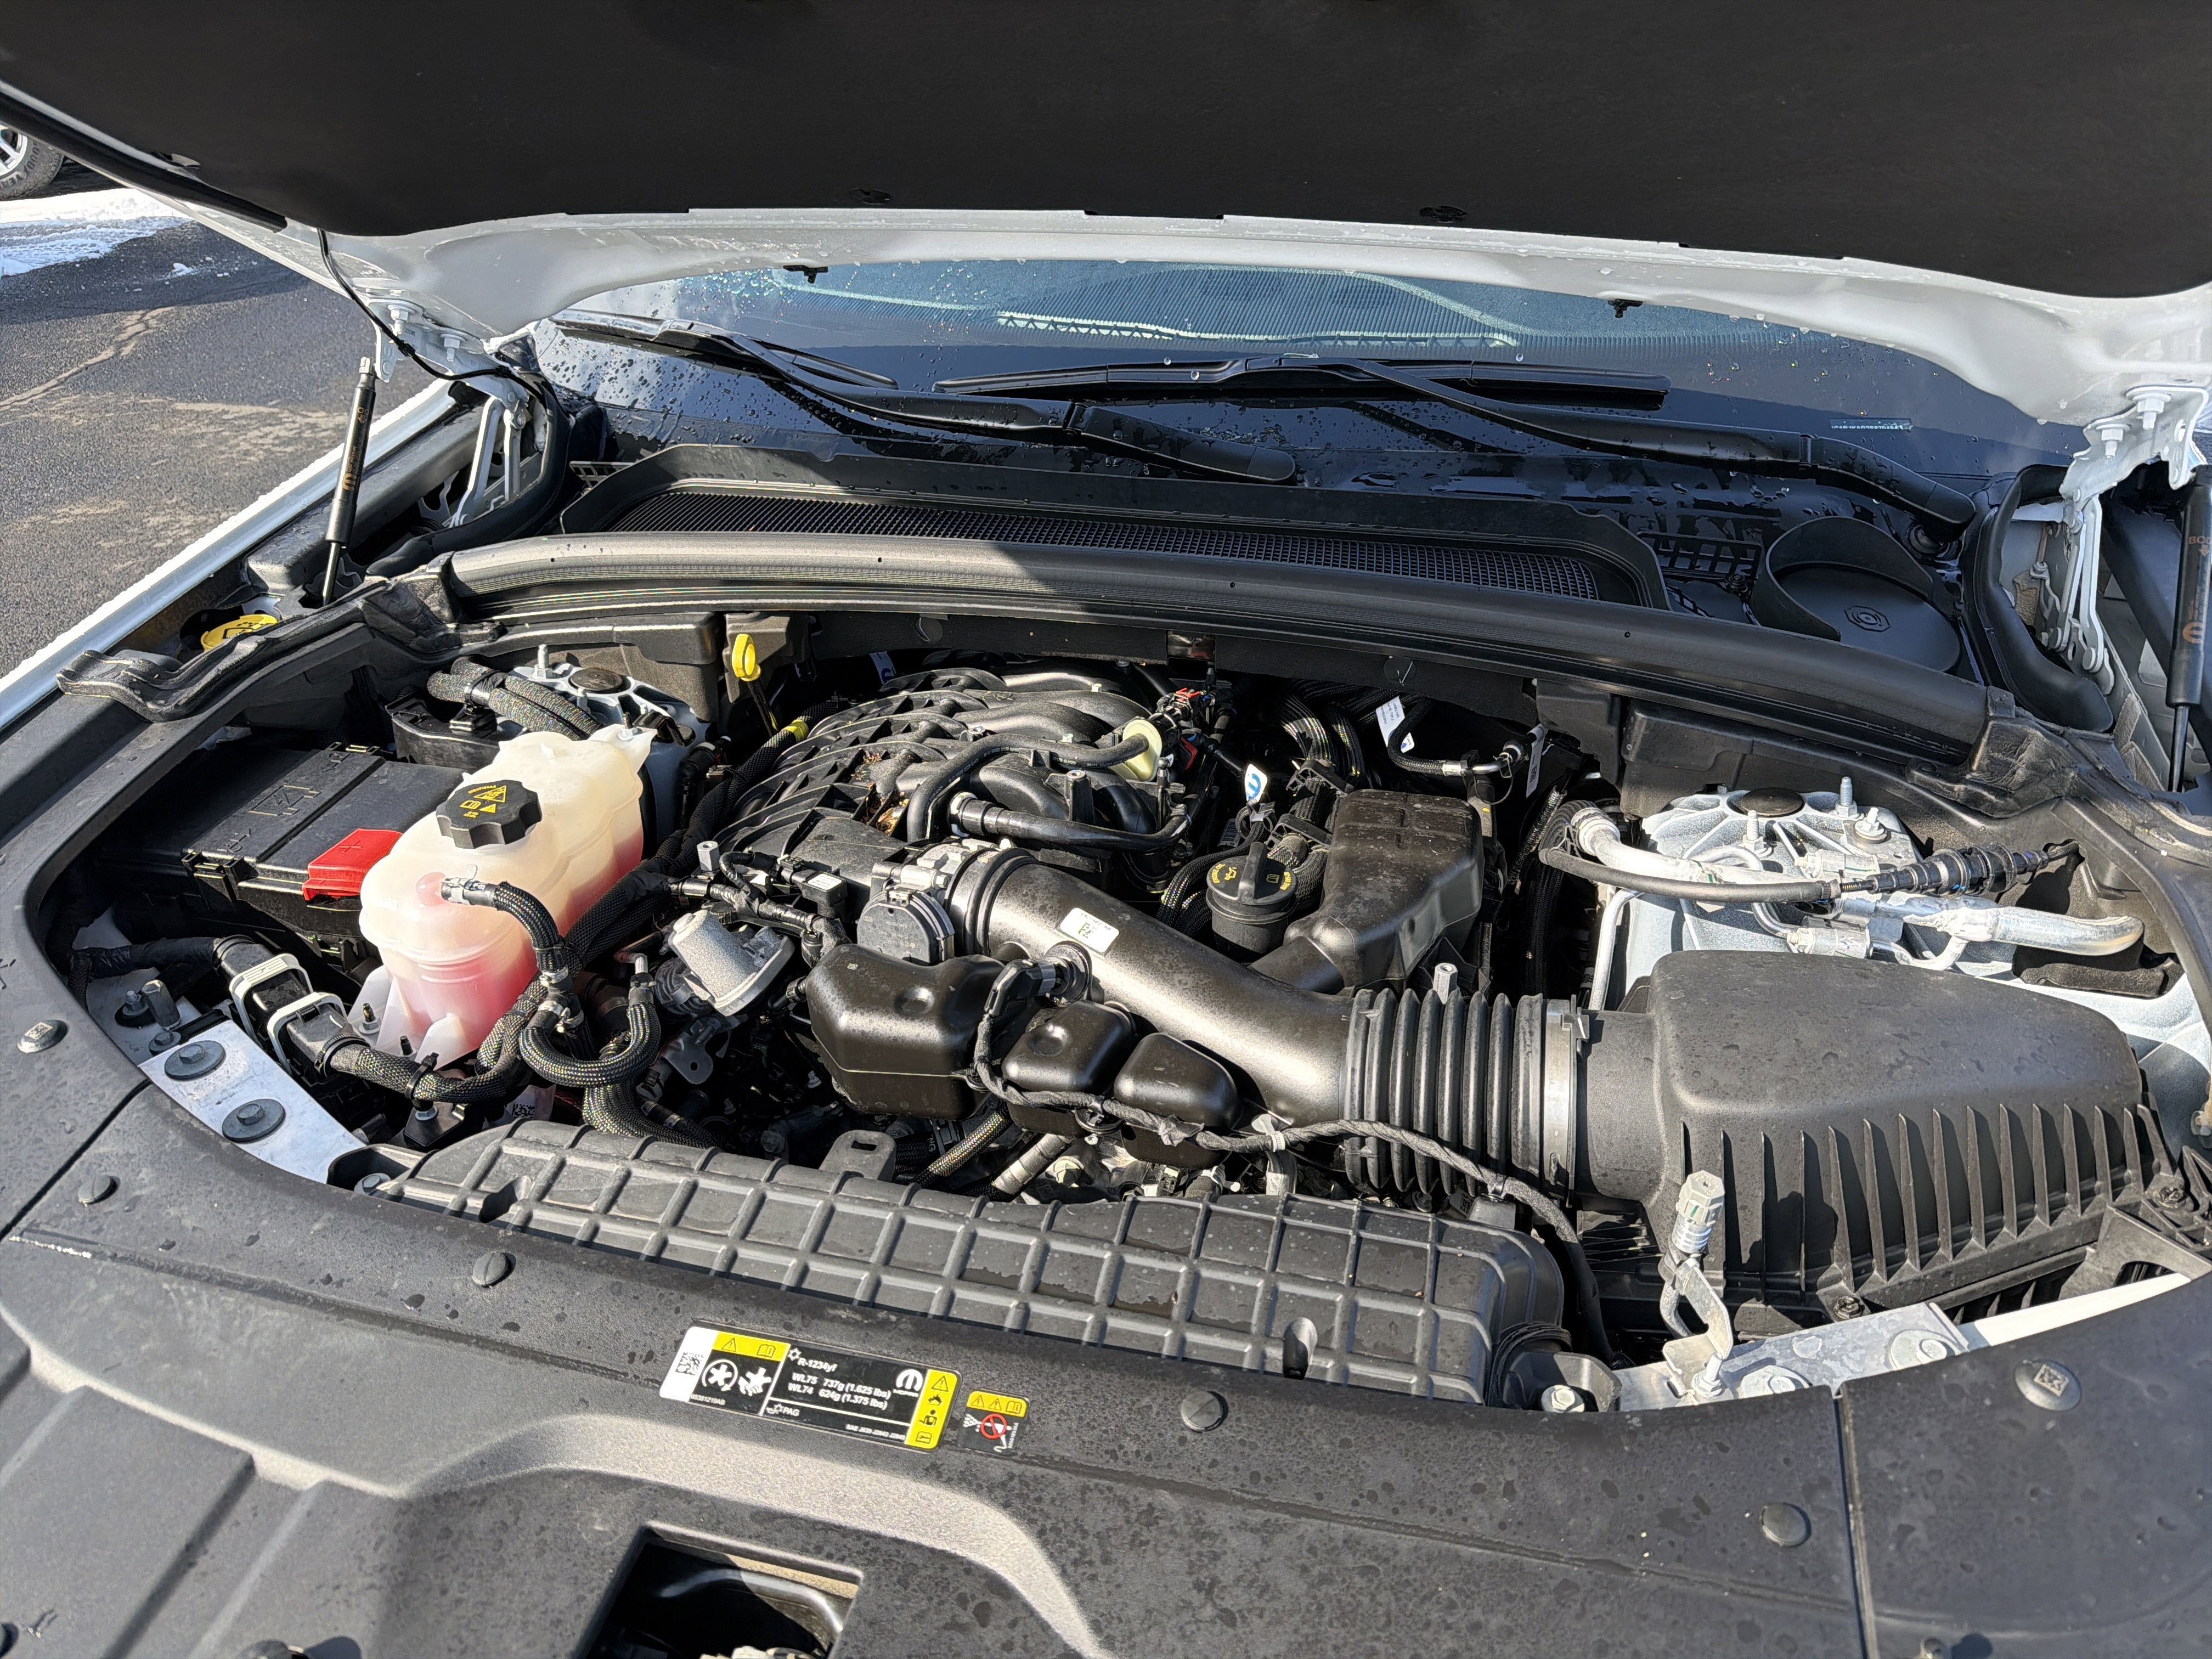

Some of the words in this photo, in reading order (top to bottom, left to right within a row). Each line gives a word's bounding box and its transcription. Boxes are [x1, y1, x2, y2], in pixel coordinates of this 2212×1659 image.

[2188, 536, 2212, 545] BOD
[797, 1357, 838, 1373] R-1234yf
[792, 1372, 818, 1385] WL75
[823, 1378, 845, 1391] 737g
[845, 1383, 873, 1395] (1.625
[873, 1389, 891, 1400] lbs)
[788, 1383, 814, 1395] WL74
[819, 1388, 841, 1402] 624g
[841, 1393, 870, 1406] (1.375
[870, 1399, 888, 1410] lbs)
[782, 1406, 800, 1417] PAG
[845, 1424, 859, 1432] SAE
